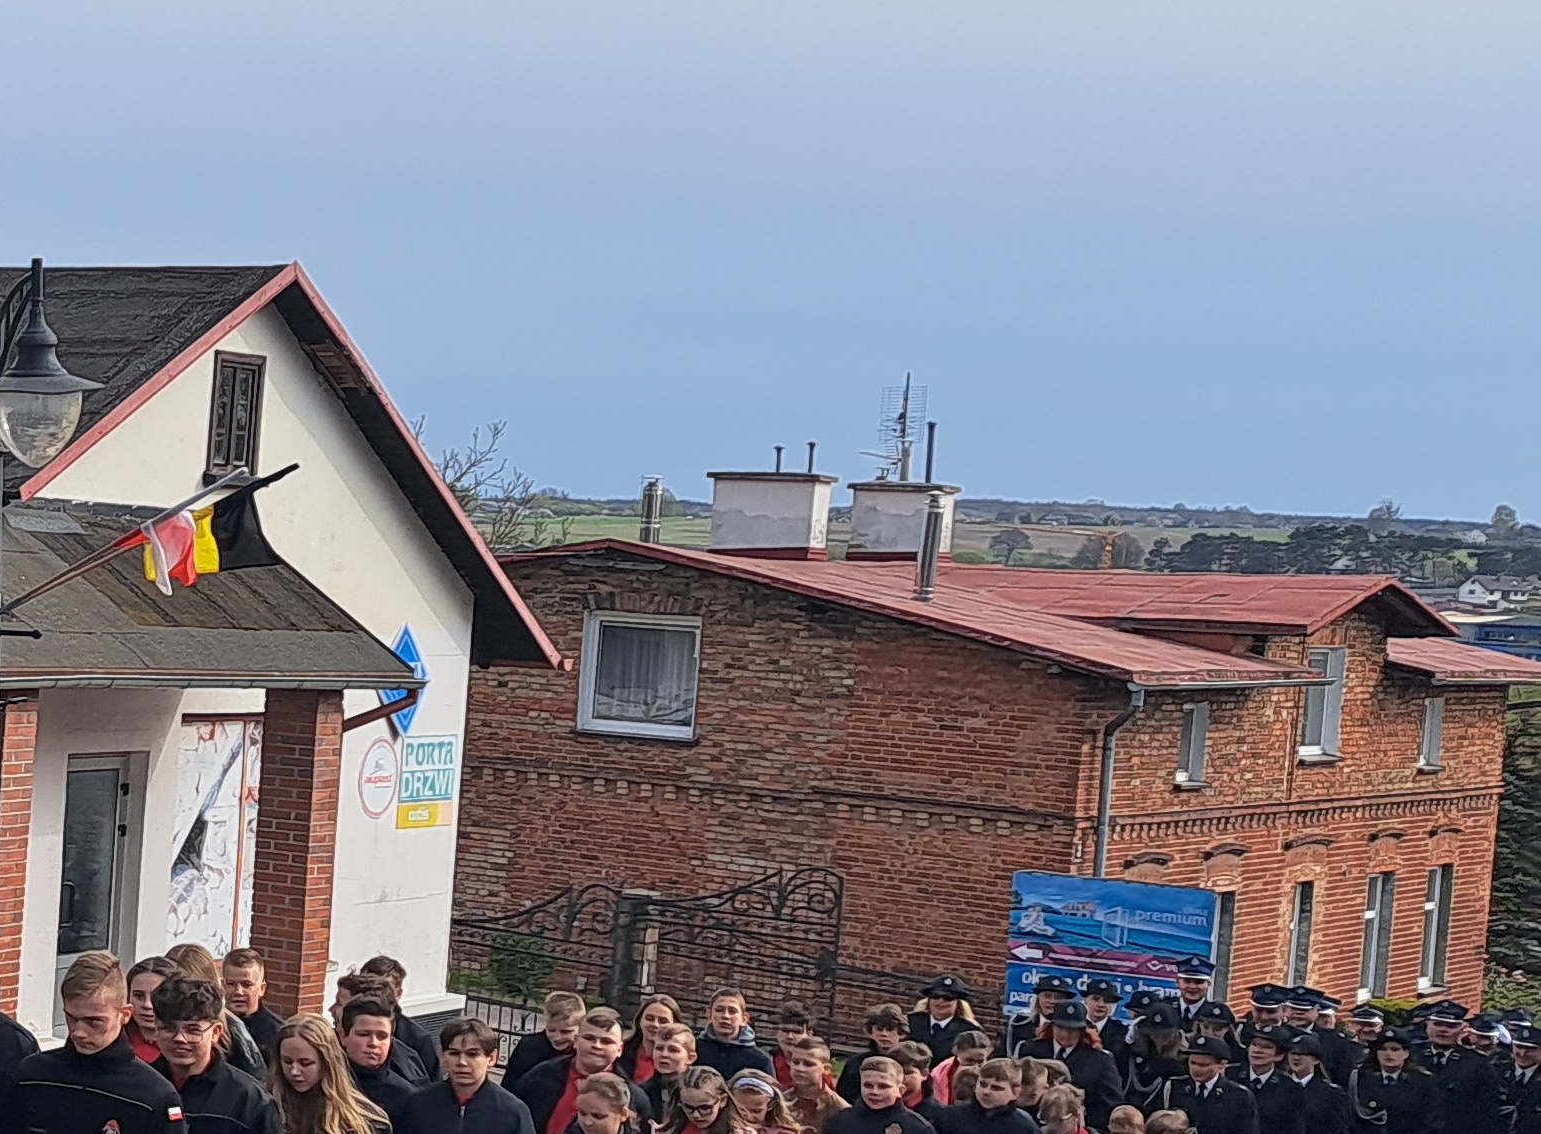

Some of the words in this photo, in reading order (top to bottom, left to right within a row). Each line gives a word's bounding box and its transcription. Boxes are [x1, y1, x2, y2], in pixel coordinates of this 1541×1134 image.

[405, 740, 454, 767] PORTA
[400, 770, 453, 798] DRZWI
[1135, 909, 1208, 928] premium
